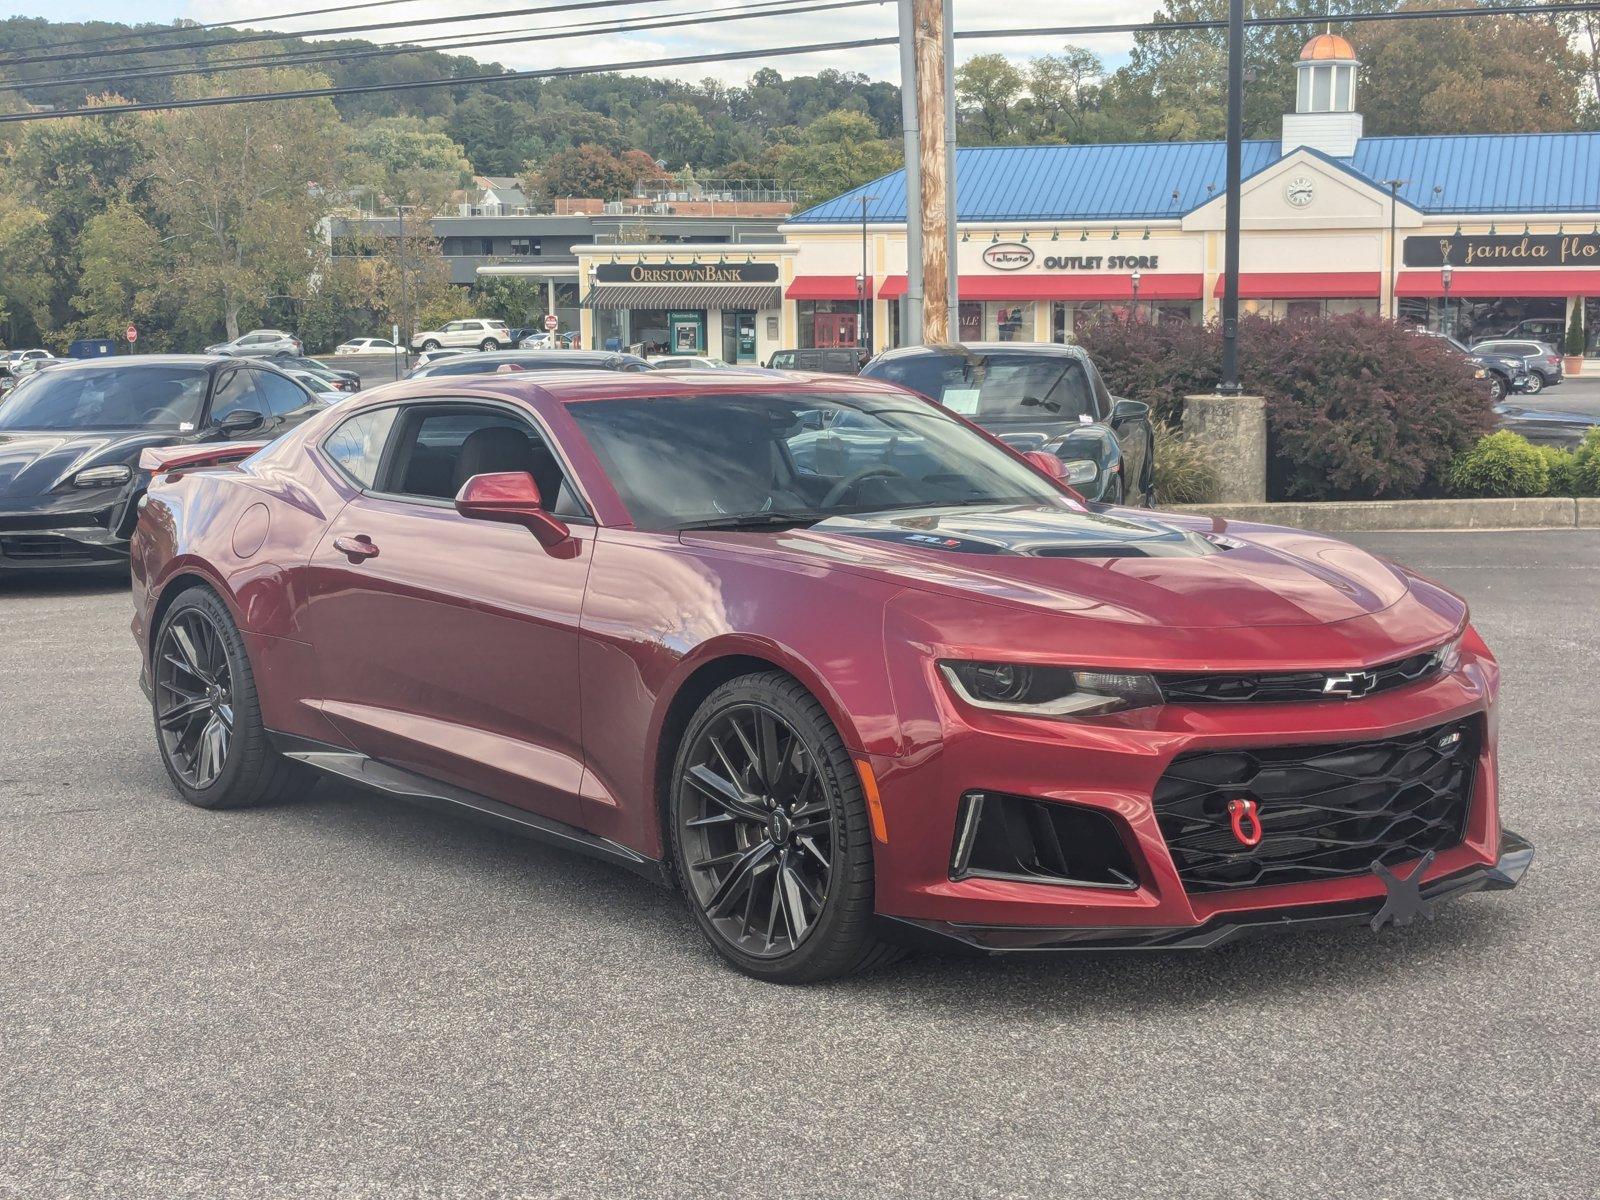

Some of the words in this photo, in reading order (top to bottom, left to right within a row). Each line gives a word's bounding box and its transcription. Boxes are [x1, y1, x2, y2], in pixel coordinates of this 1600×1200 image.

[1465, 238, 1549, 264] janda
[1561, 237, 1600, 264] flo
[1044, 256, 1103, 269] OUTLET
[1107, 255, 1159, 269] STORE
